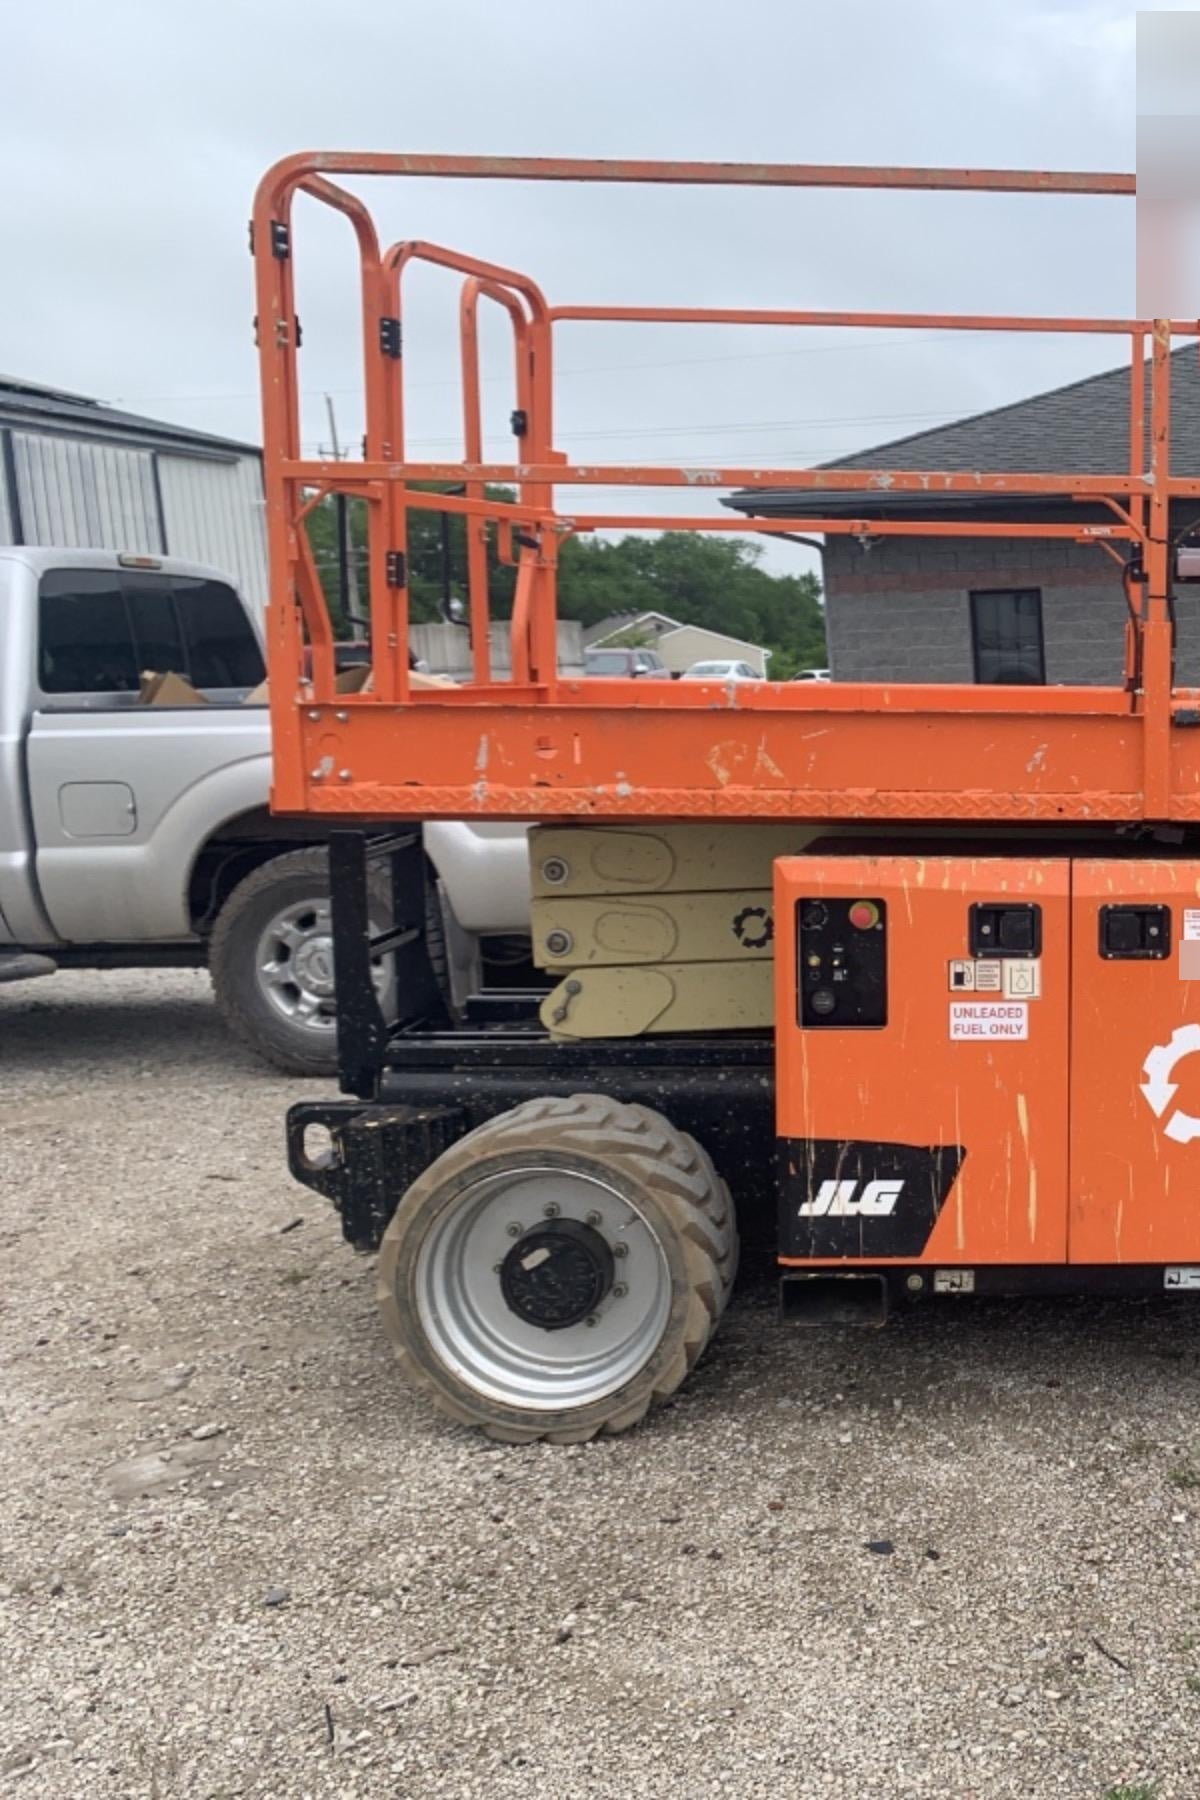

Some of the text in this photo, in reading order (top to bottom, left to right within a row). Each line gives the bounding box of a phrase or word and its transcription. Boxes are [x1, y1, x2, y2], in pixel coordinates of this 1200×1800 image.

[953, 1007, 1024, 1019] UNLEADED
[953, 1023, 1024, 1035] FUEL ONLY
[798, 1180, 905, 1216] JLG
